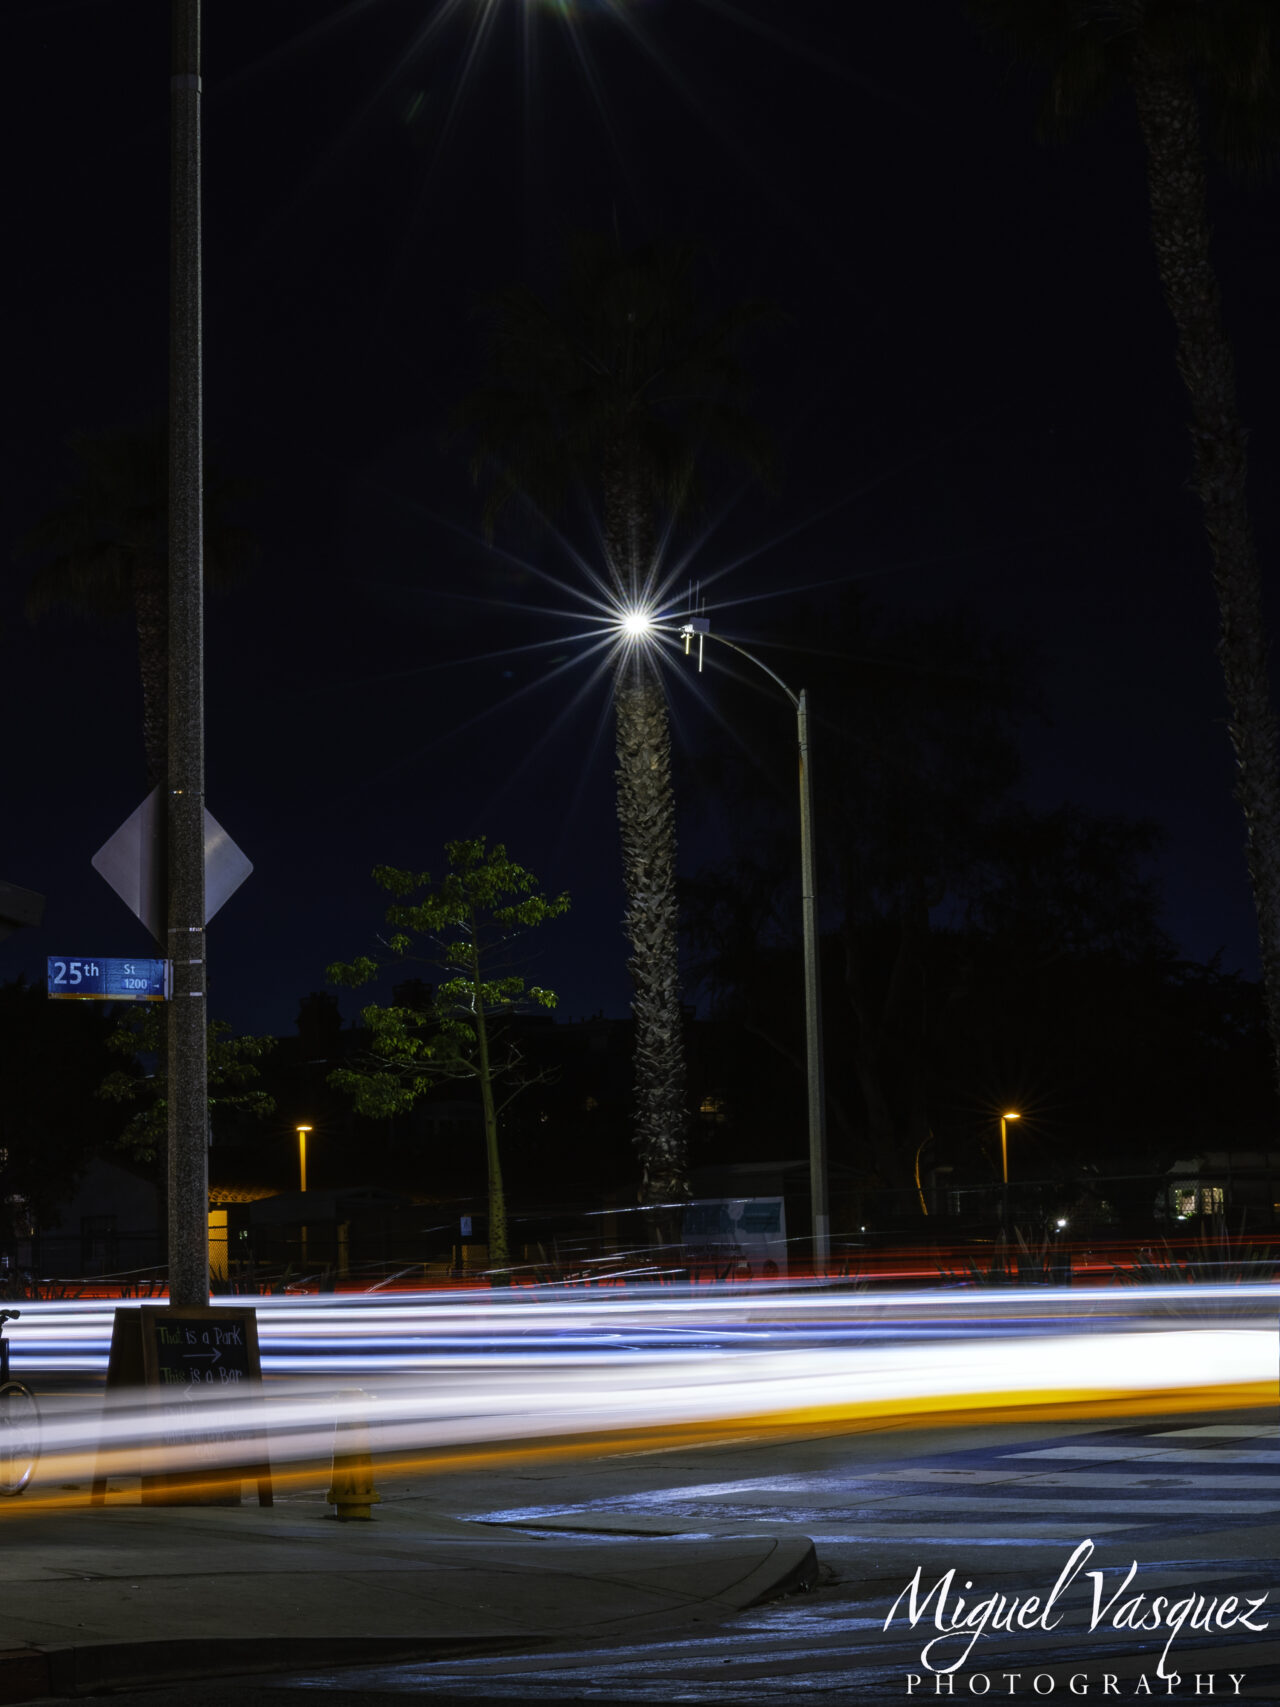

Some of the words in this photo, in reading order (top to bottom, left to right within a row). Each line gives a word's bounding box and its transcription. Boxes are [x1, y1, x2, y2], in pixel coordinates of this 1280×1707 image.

[53, 961, 100, 985] 25th
[123, 963, 137, 975] St
[124, 978, 148, 989] 1200
[185, 1327, 198, 1345] is
[202, 1331, 210, 1345] a
[212, 1325, 243, 1345] Park
[189, 1367, 201, 1385] is
[205, 1368, 214, 1385] a
[219, 1366, 242, 1385] Bar
